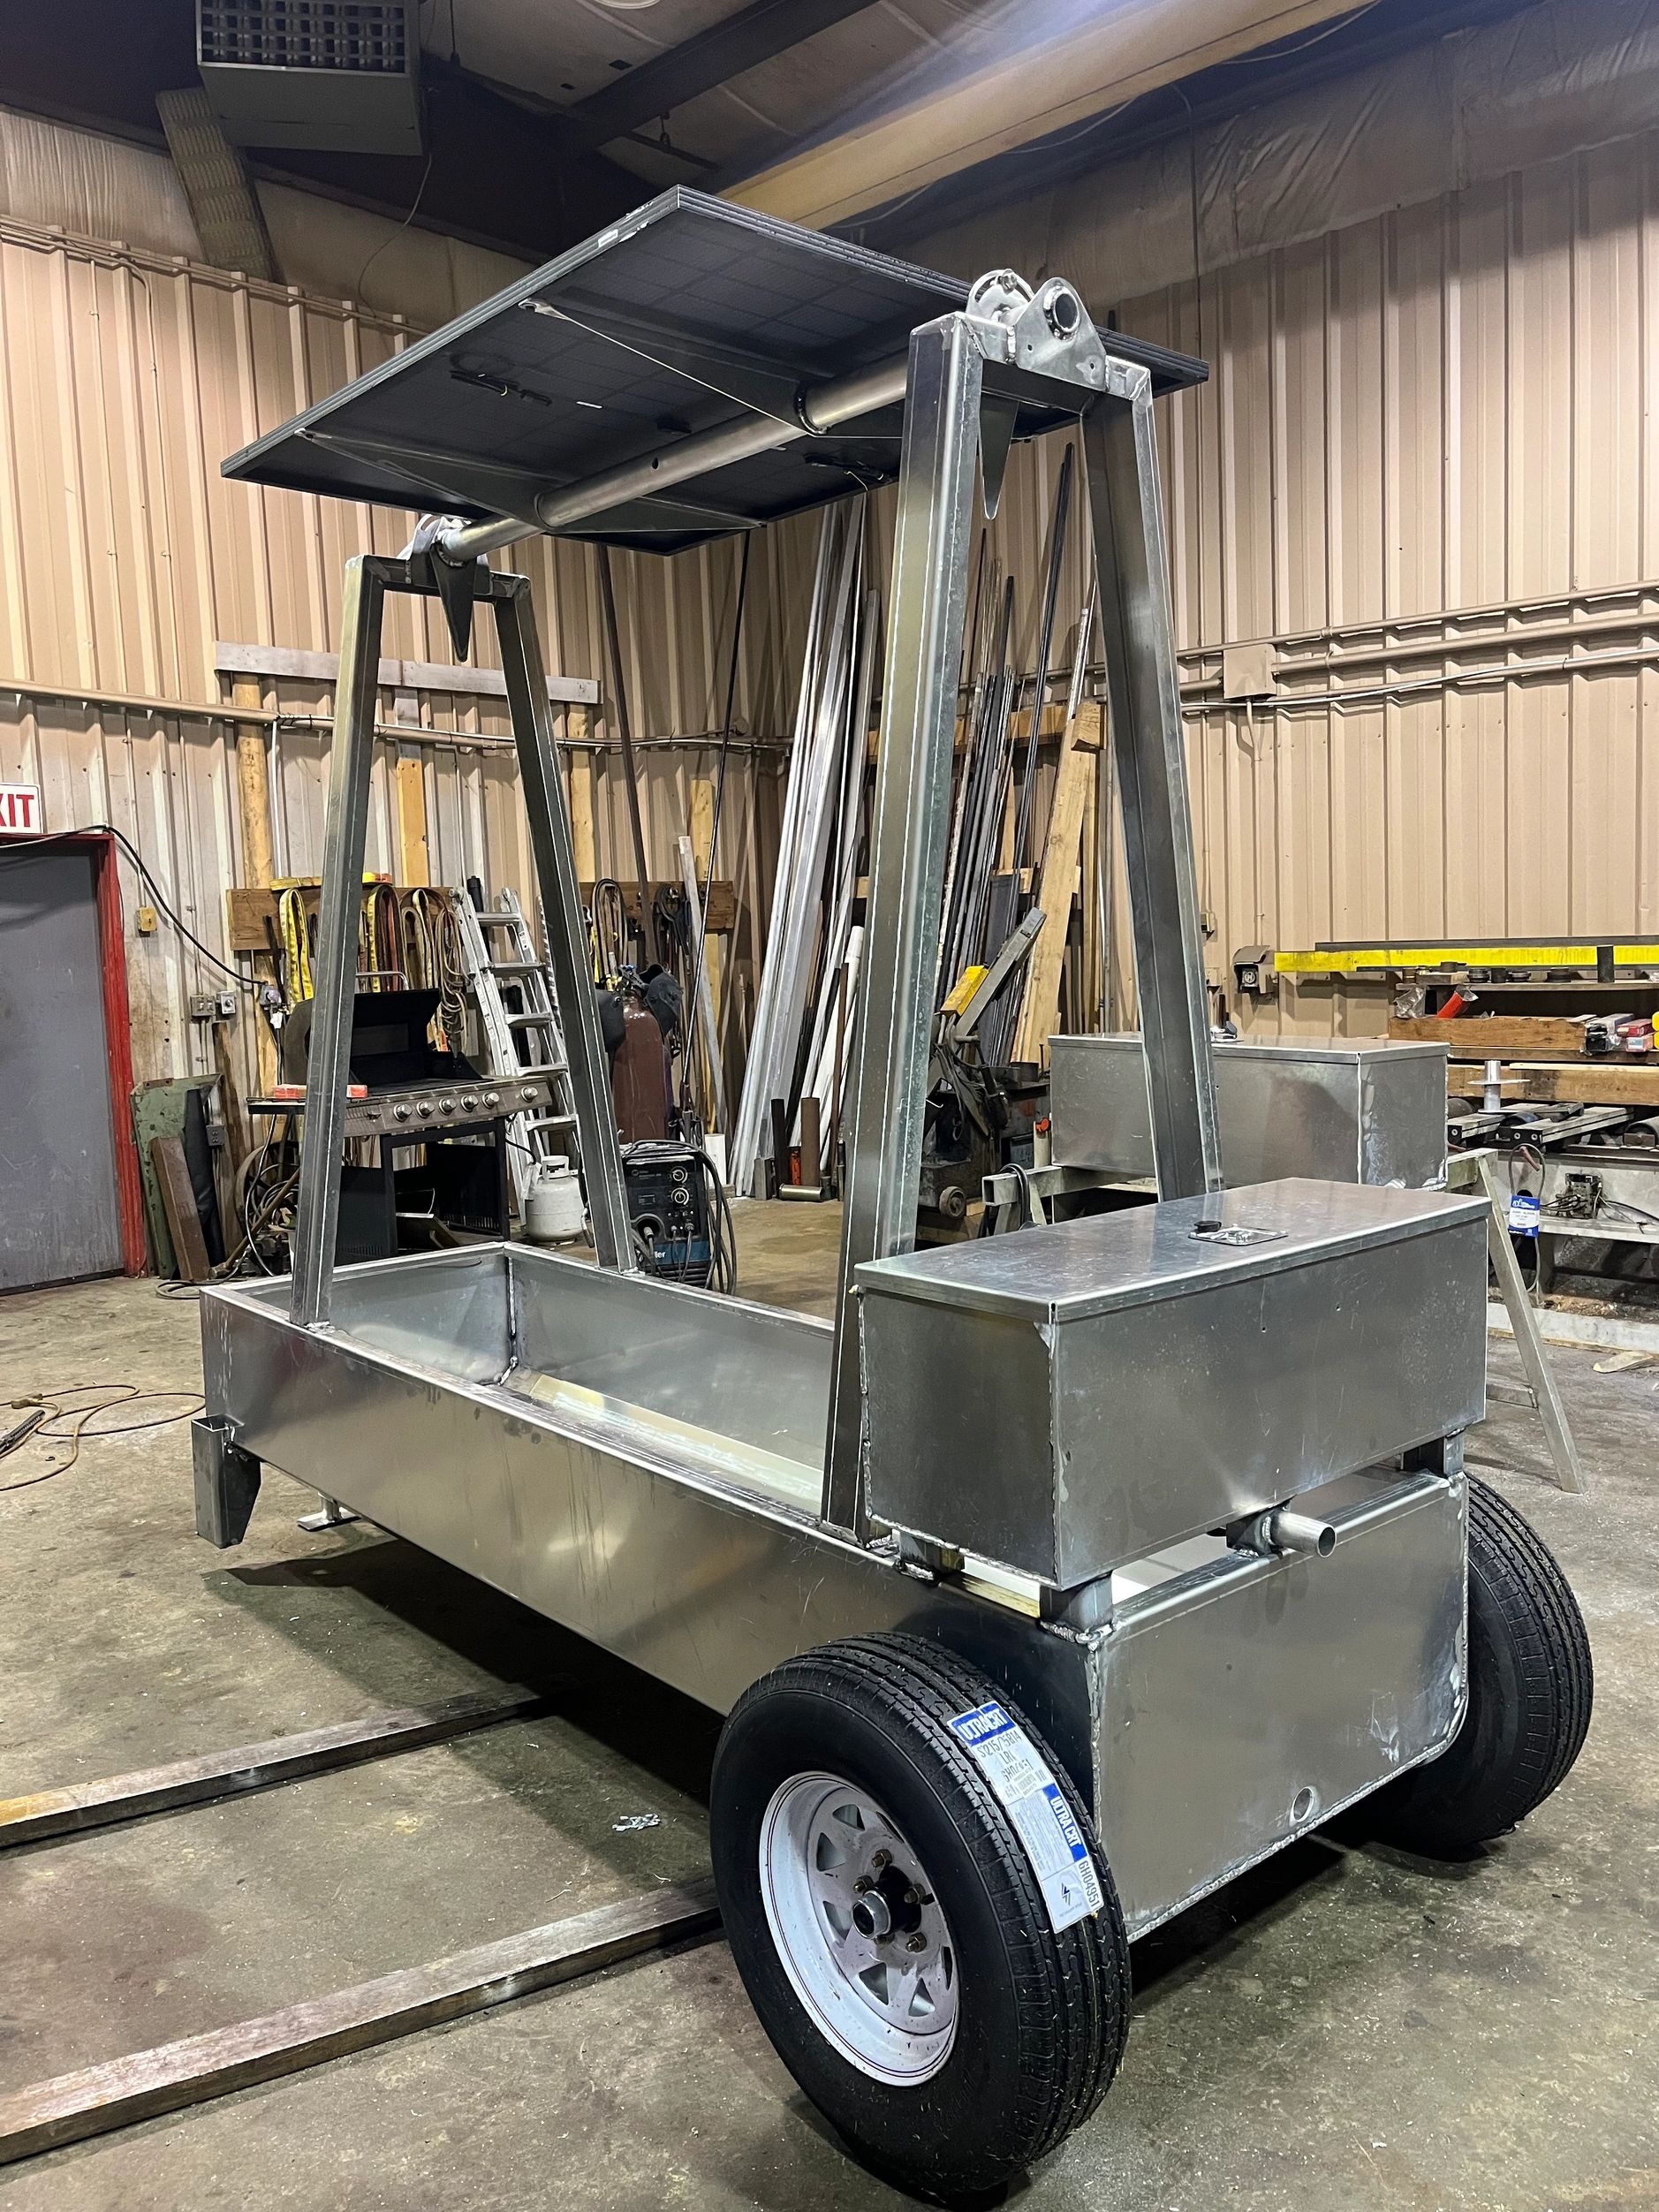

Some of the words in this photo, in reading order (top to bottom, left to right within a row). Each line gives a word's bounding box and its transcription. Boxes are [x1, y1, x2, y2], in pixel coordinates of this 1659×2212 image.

[1050, 1795, 1071, 1829] ULTRA
[1064, 1823, 1082, 1847] CRT
[1079, 1860, 1100, 1908] 6H04951
